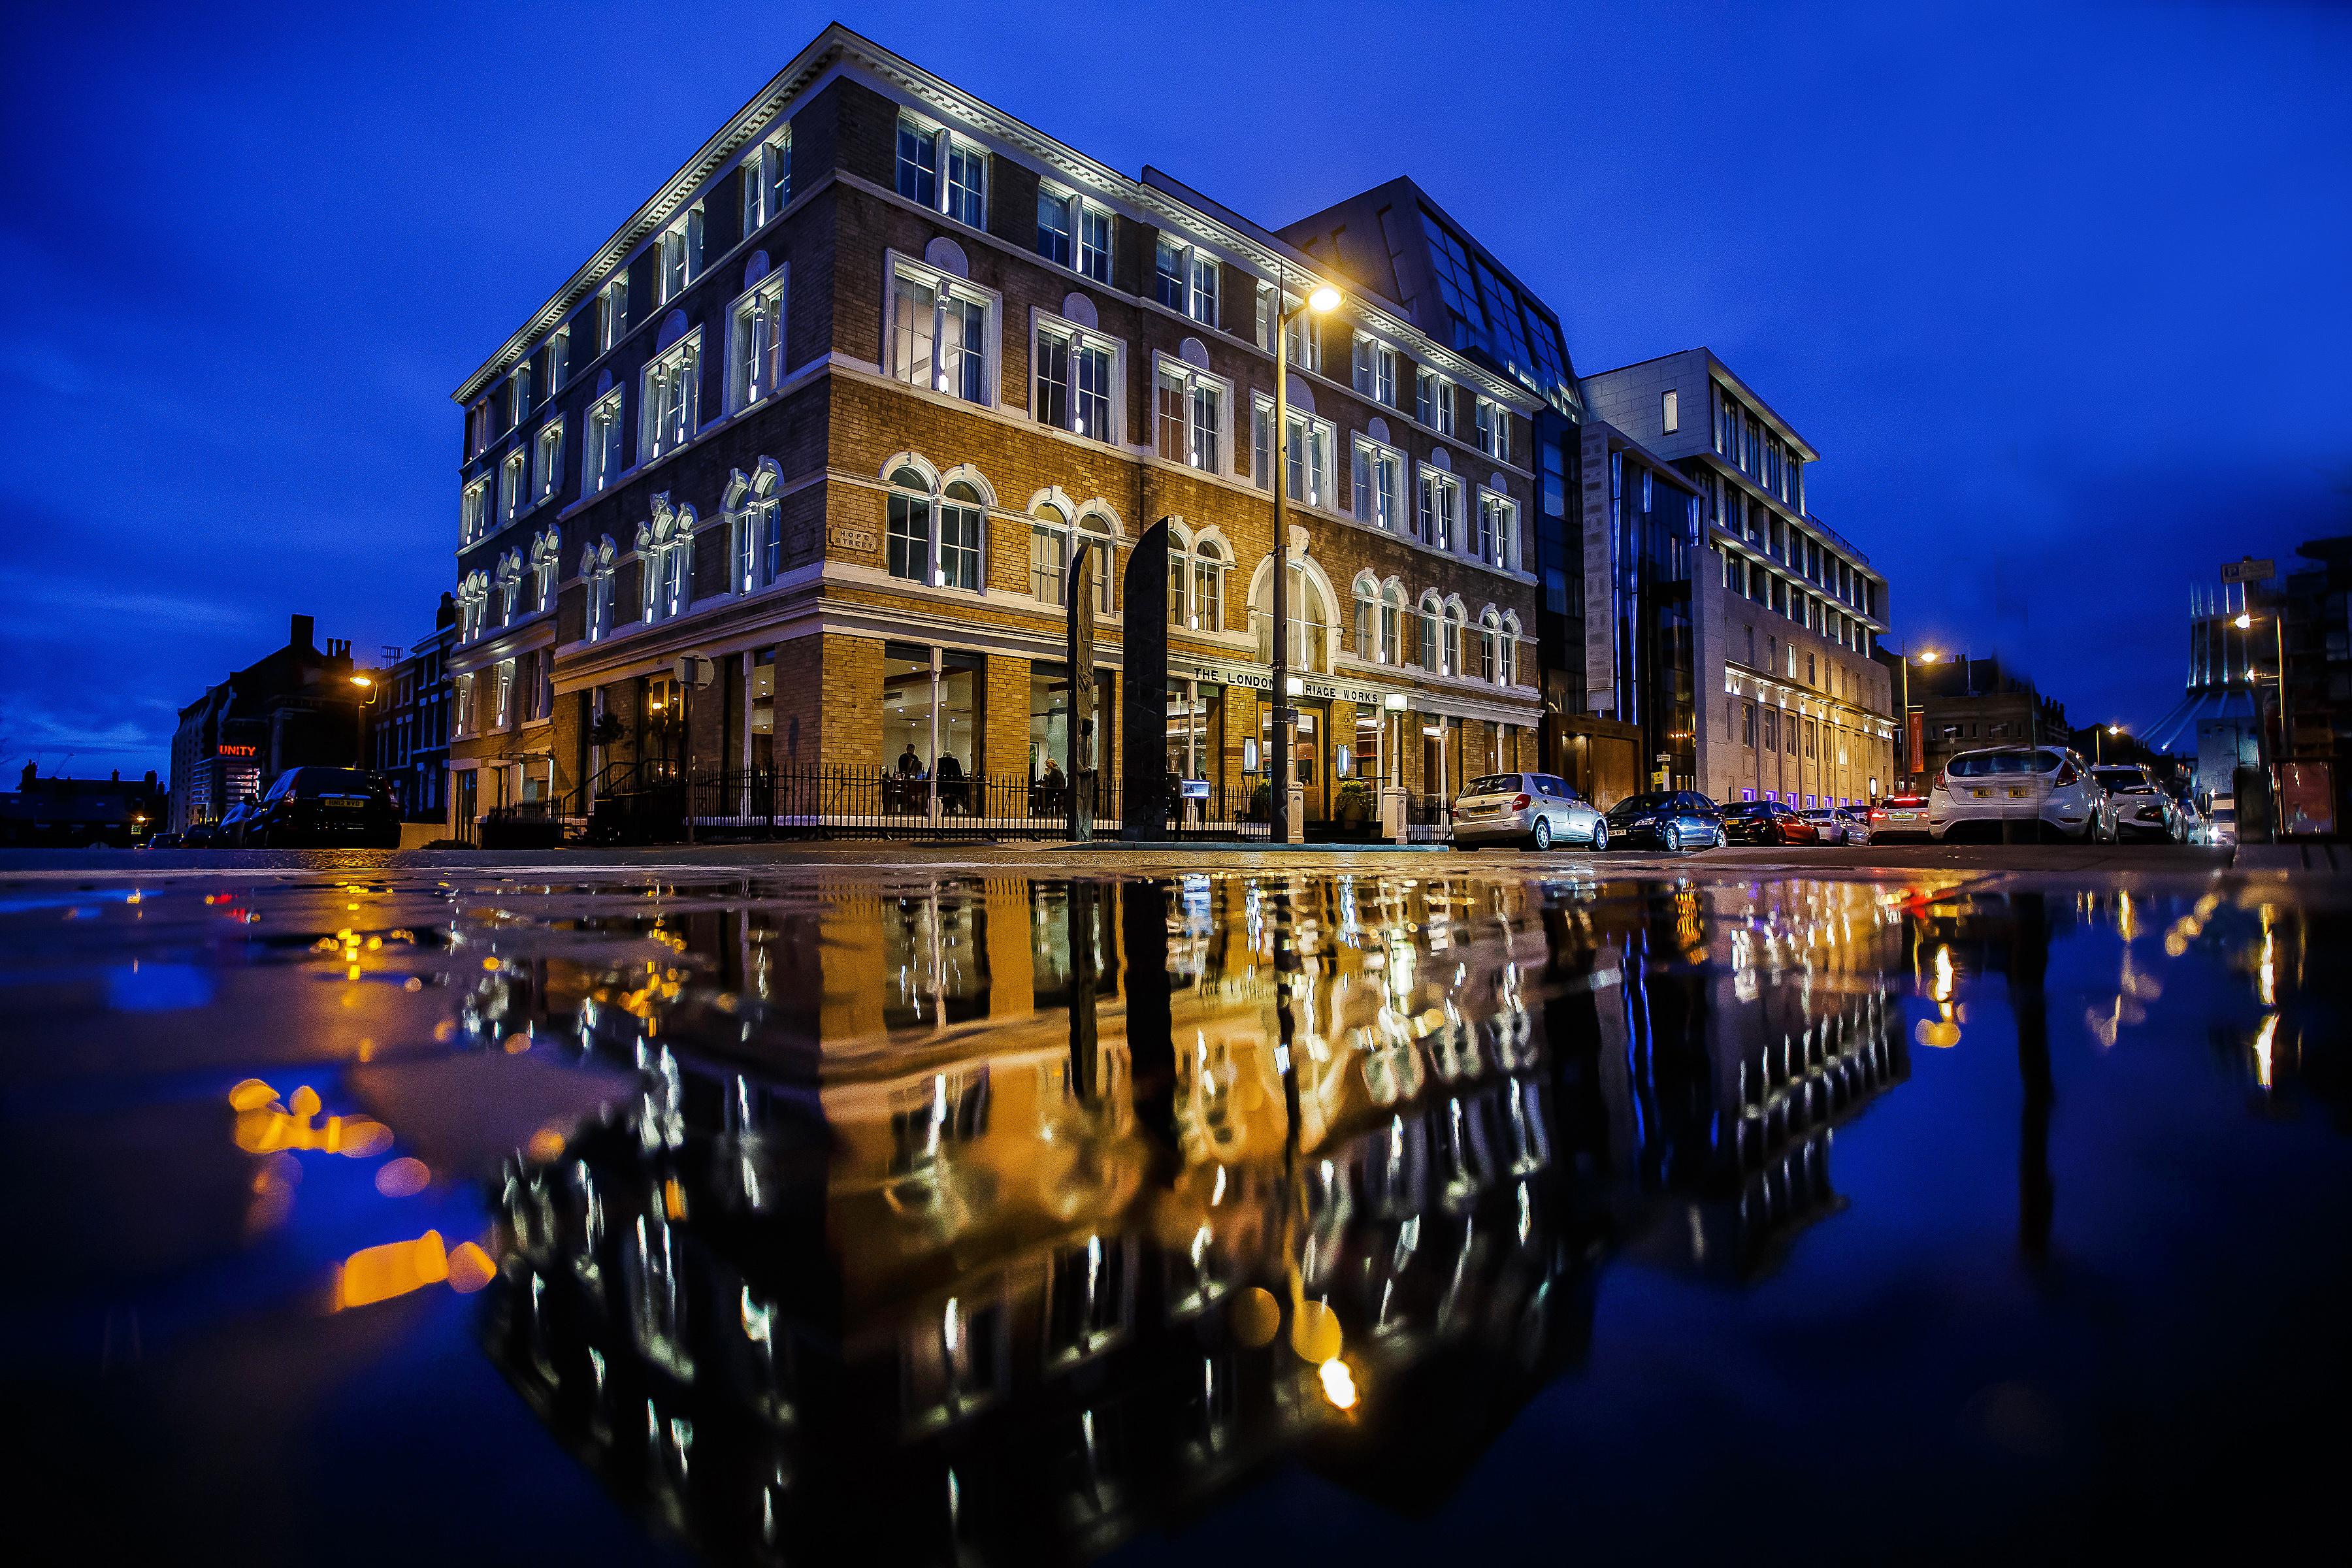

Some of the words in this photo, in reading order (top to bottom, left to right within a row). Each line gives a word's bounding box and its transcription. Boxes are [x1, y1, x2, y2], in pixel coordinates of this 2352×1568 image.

[840, 531, 870, 541] HOPE
[836, 538, 873, 548] STREET
[1194, 668, 1218, 681] THE
[1306, 684, 1335, 697] RIAGE
[1343, 689, 1378, 702] WORKS
[220, 745, 255, 756] UNITY
